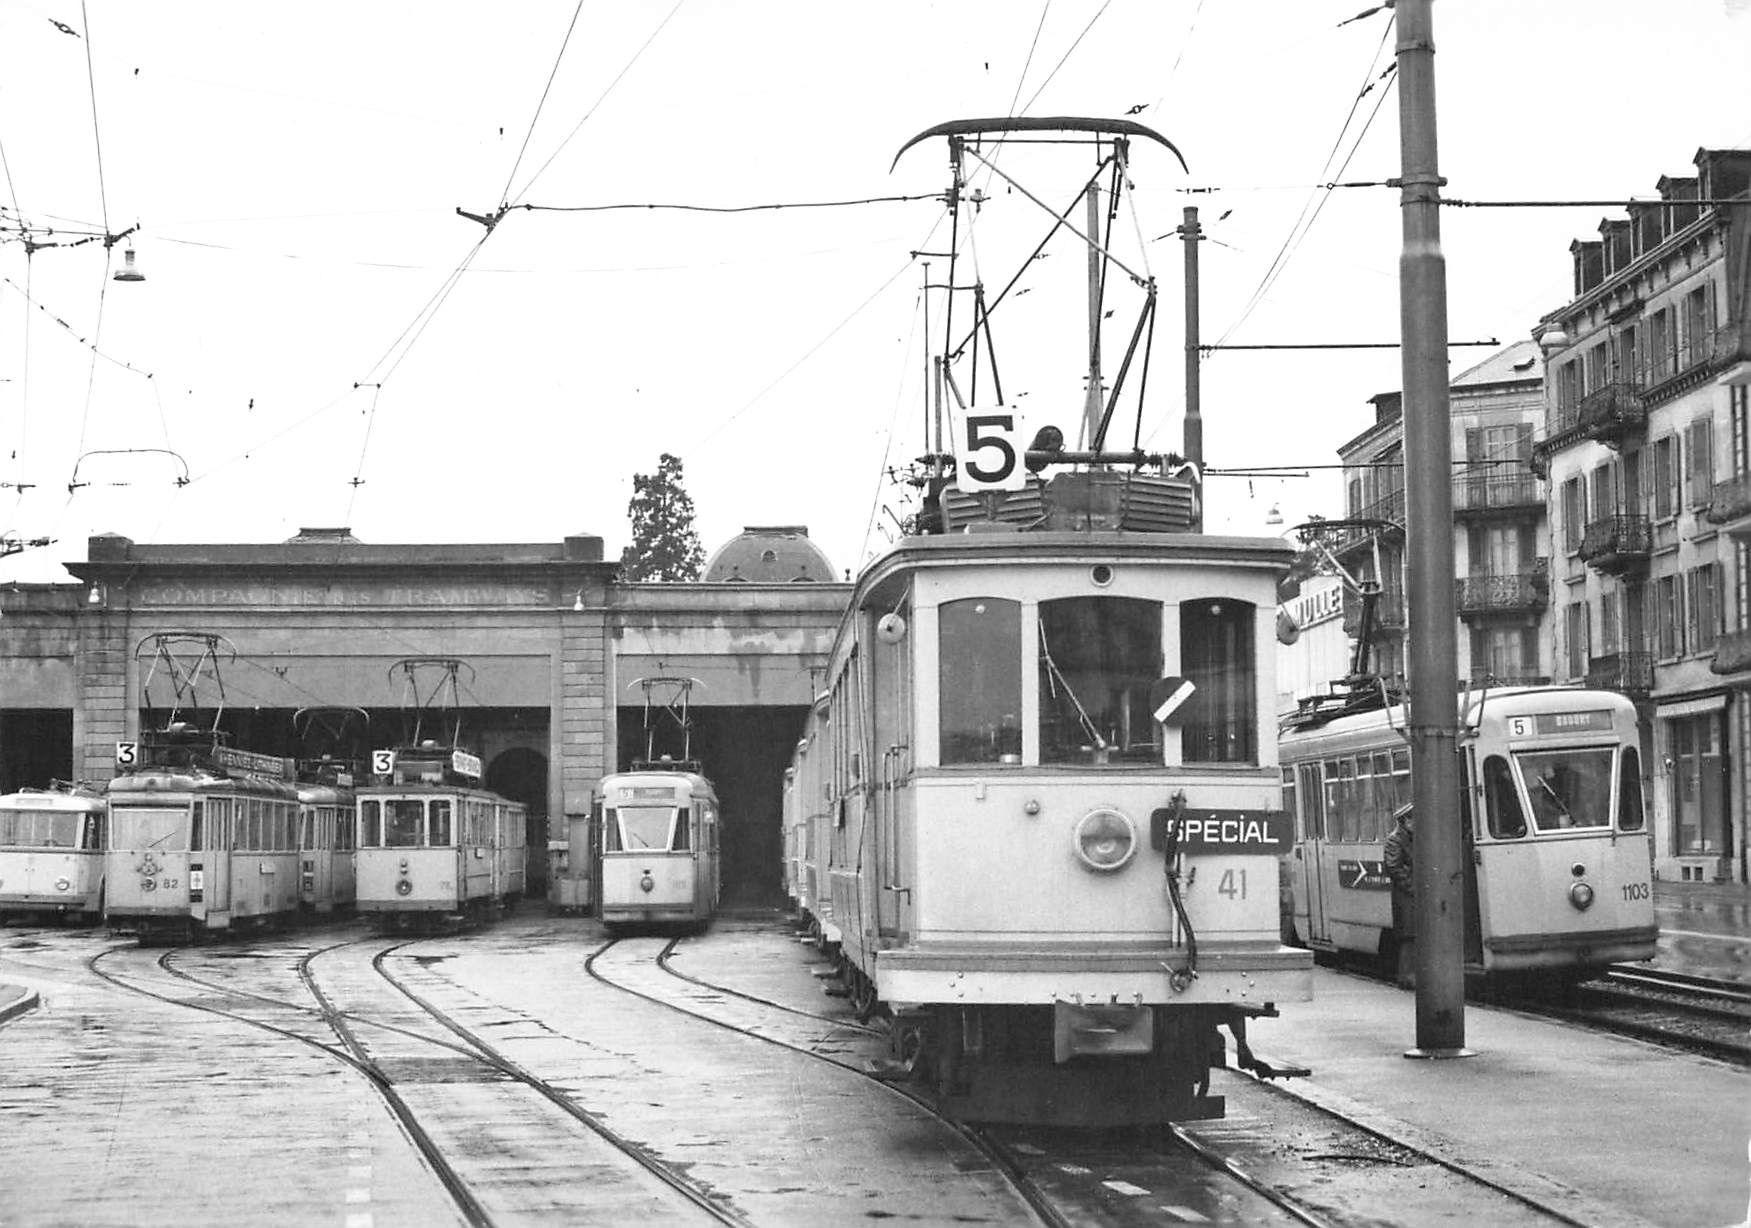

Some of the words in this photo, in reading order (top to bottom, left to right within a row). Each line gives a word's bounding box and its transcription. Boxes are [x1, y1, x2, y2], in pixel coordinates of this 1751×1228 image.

[965, 415, 1016, 483] 5
[1514, 719, 1524, 735] 5
[118, 743, 136, 764] 3
[375, 752, 391, 772] 3
[1218, 868, 1247, 900] 41
[1622, 882, 1650, 901] 1103
